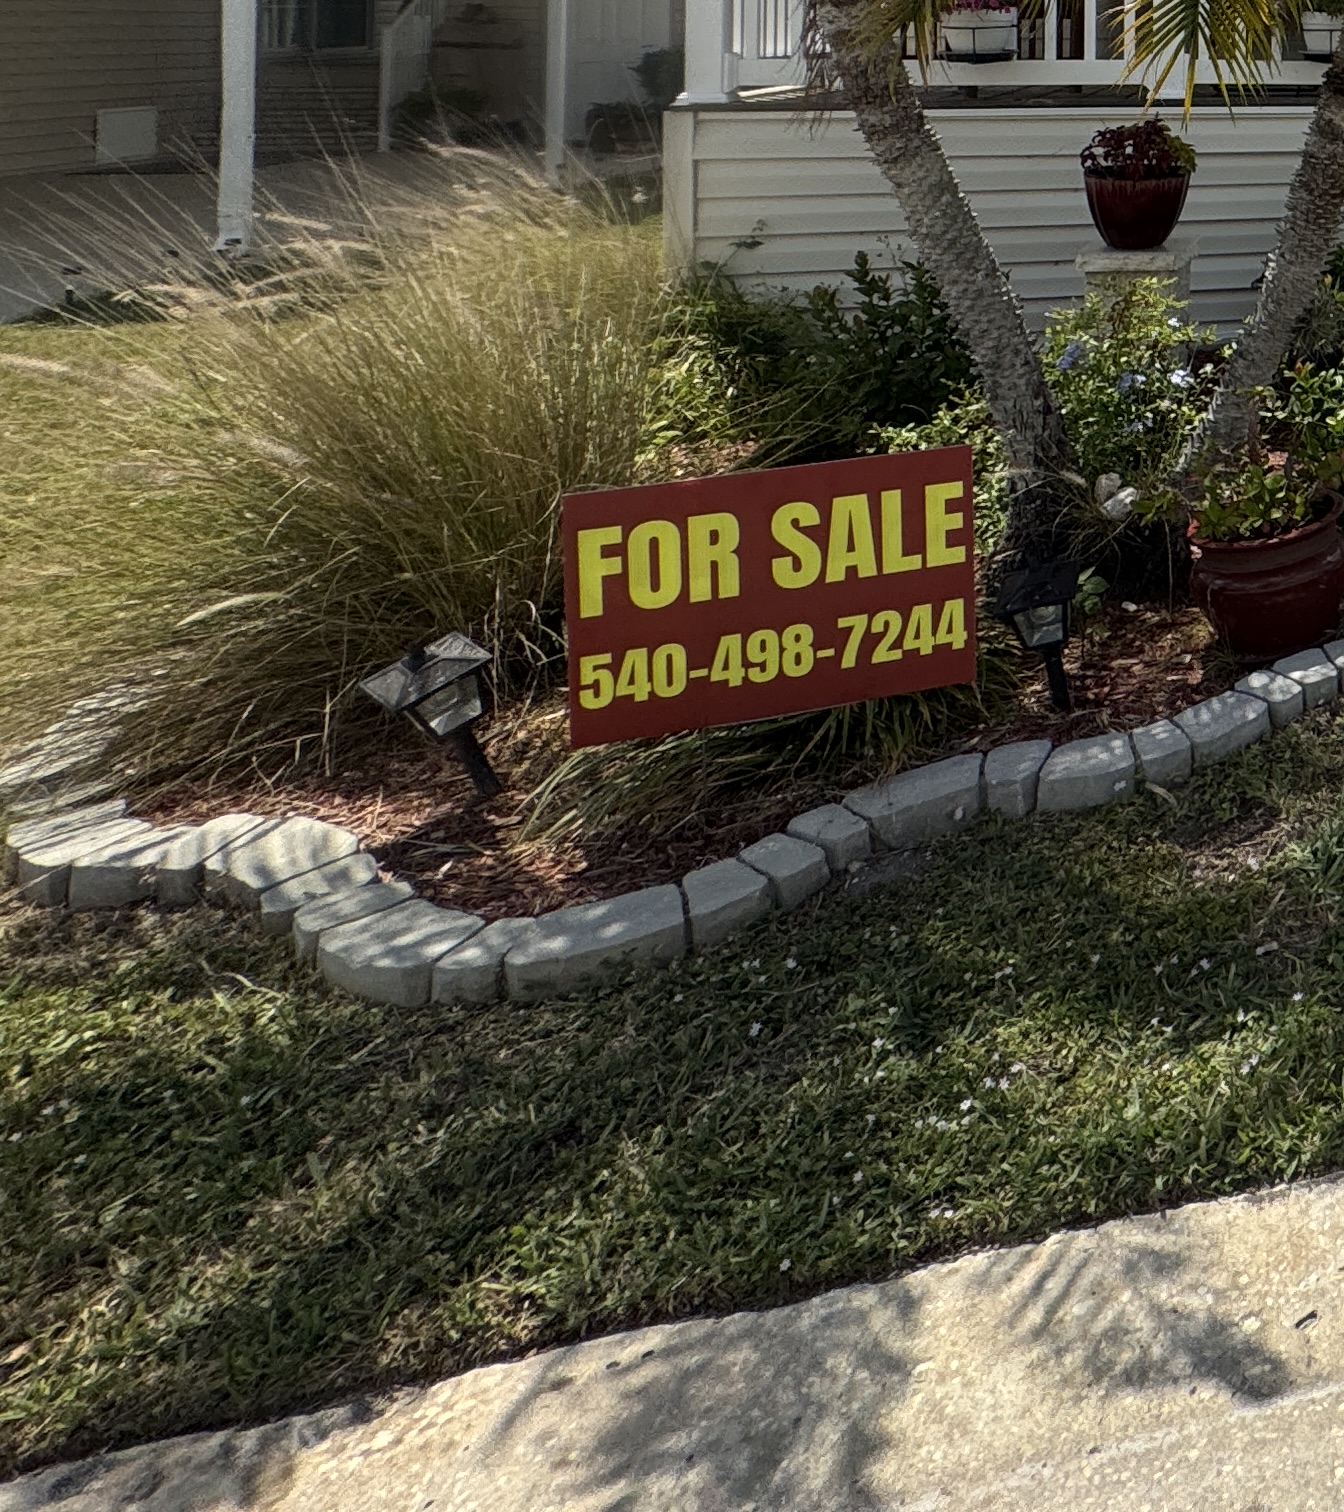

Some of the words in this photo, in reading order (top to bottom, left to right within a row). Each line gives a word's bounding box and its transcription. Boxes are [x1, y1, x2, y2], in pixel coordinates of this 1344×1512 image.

[577, 511, 740, 619] FOR
[770, 480, 967, 589] SALE
[578, 597, 968, 710] 540-498-7244
